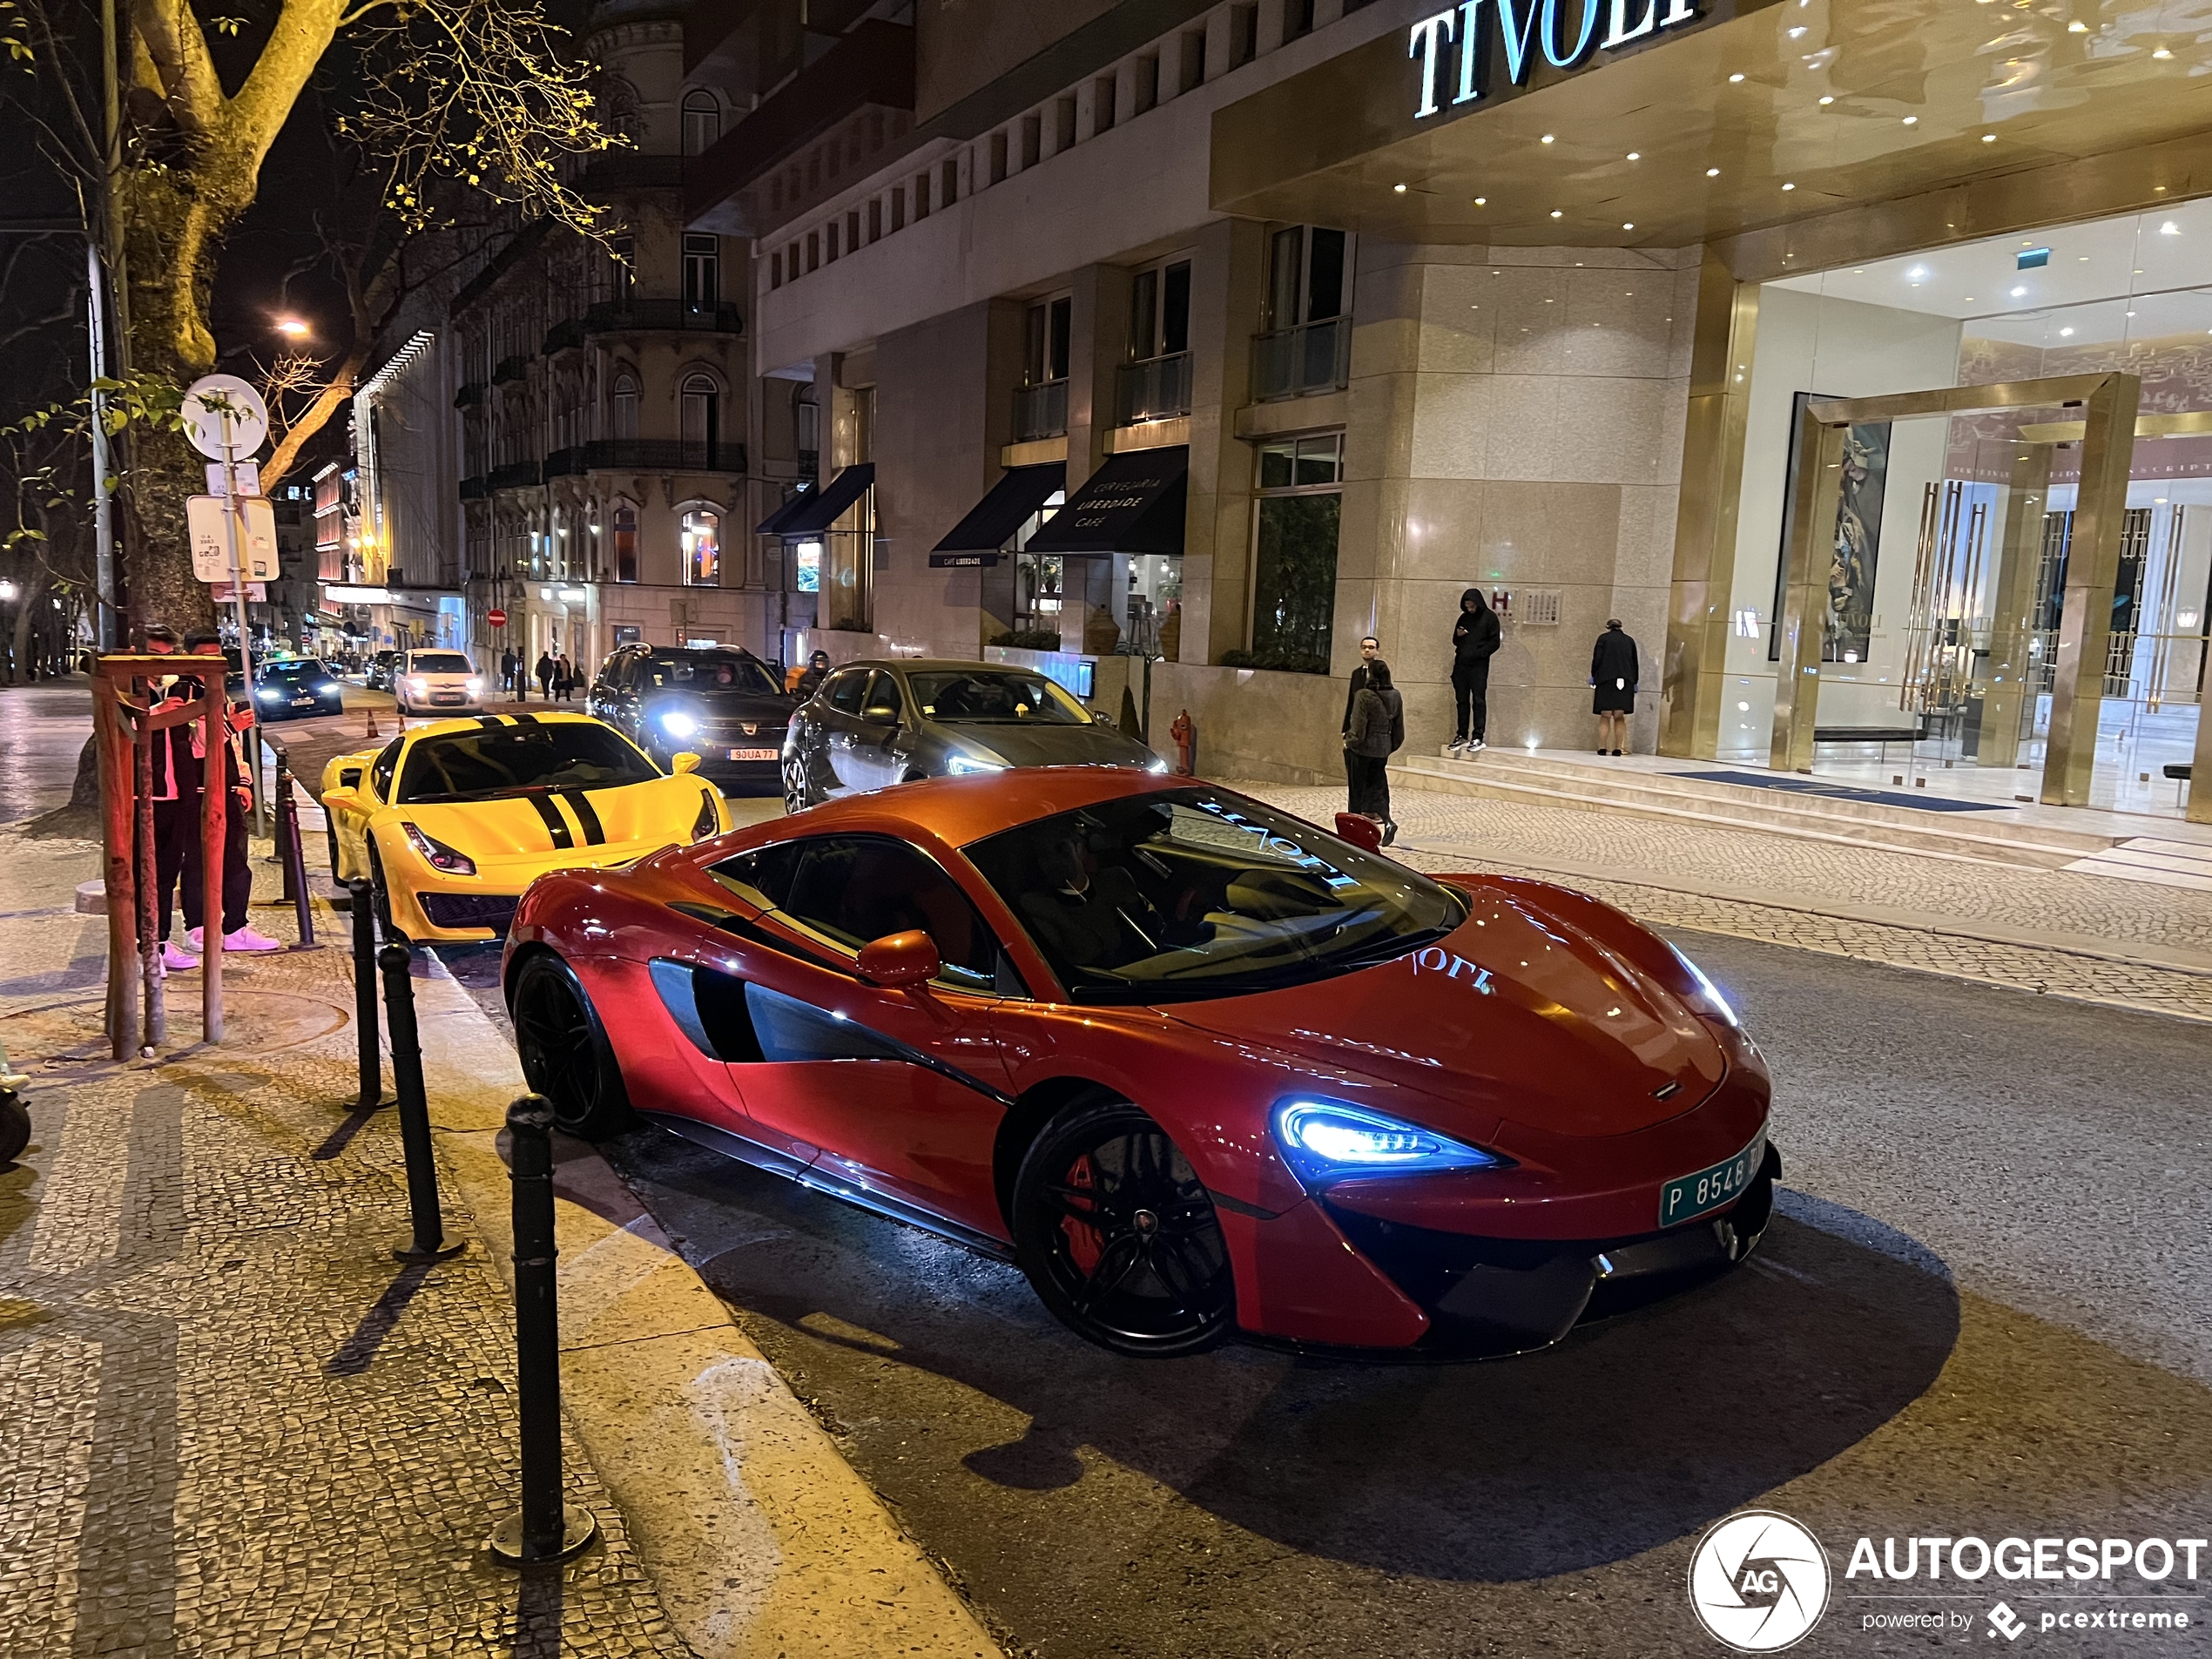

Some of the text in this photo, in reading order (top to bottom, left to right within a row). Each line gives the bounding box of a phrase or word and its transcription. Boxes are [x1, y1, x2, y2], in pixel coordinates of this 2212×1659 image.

[1076, 497, 1143, 510] LIBERDADE
[1492, 591, 1508, 610] H
[1669, 1188, 1683, 1216] P
